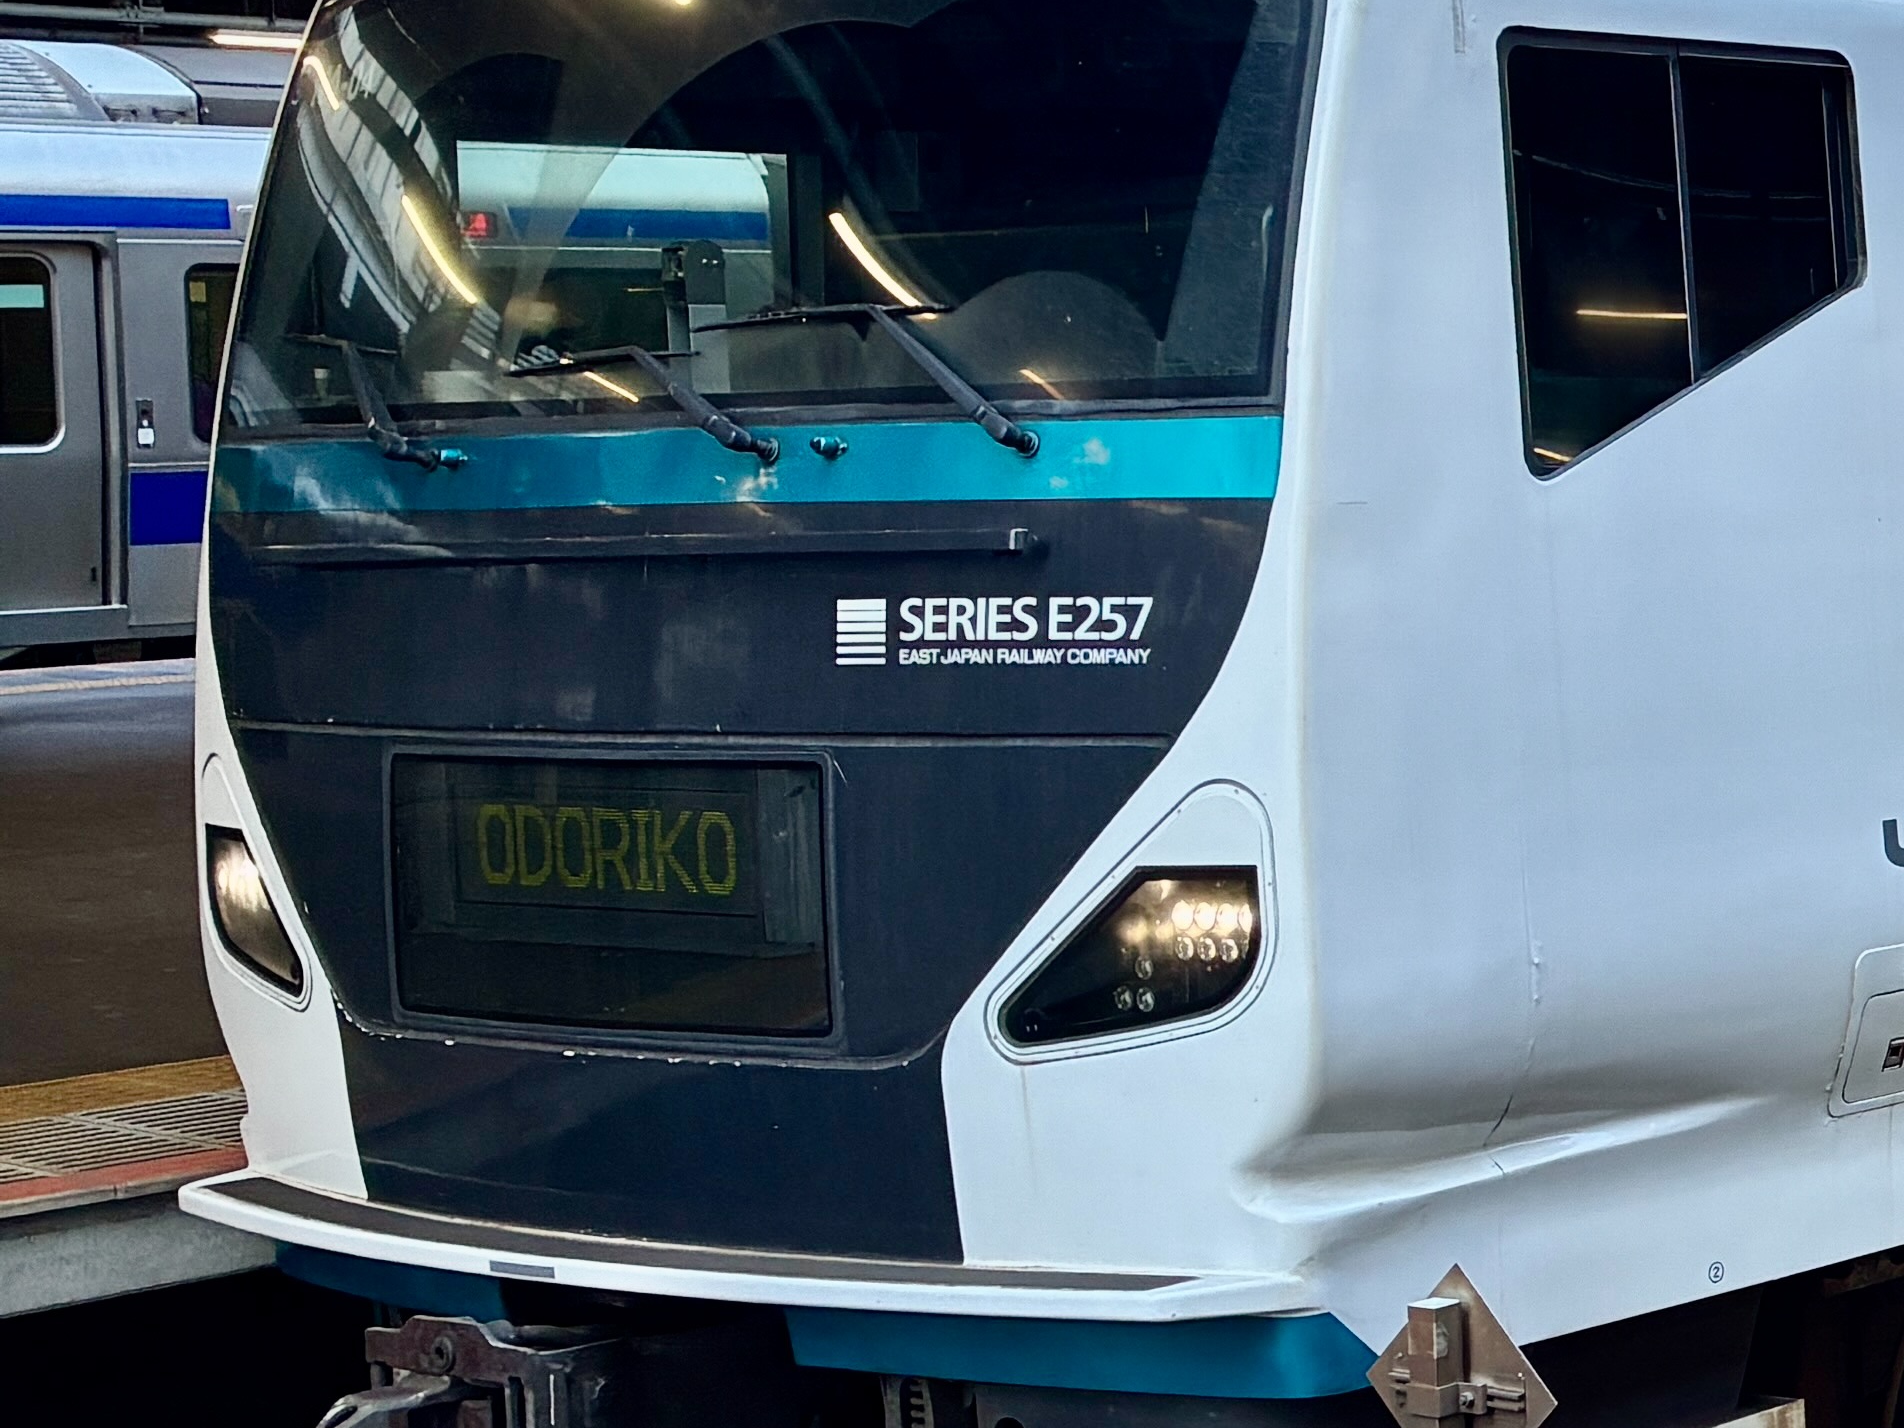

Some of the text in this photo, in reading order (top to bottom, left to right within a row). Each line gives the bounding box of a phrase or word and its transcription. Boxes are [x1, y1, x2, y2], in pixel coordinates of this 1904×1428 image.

[899, 596, 1154, 642] SERIES E257
[899, 648, 1151, 665] EAST JAPAN RAILWAY COMPANY
[476, 803, 737, 895] ODORIKO
